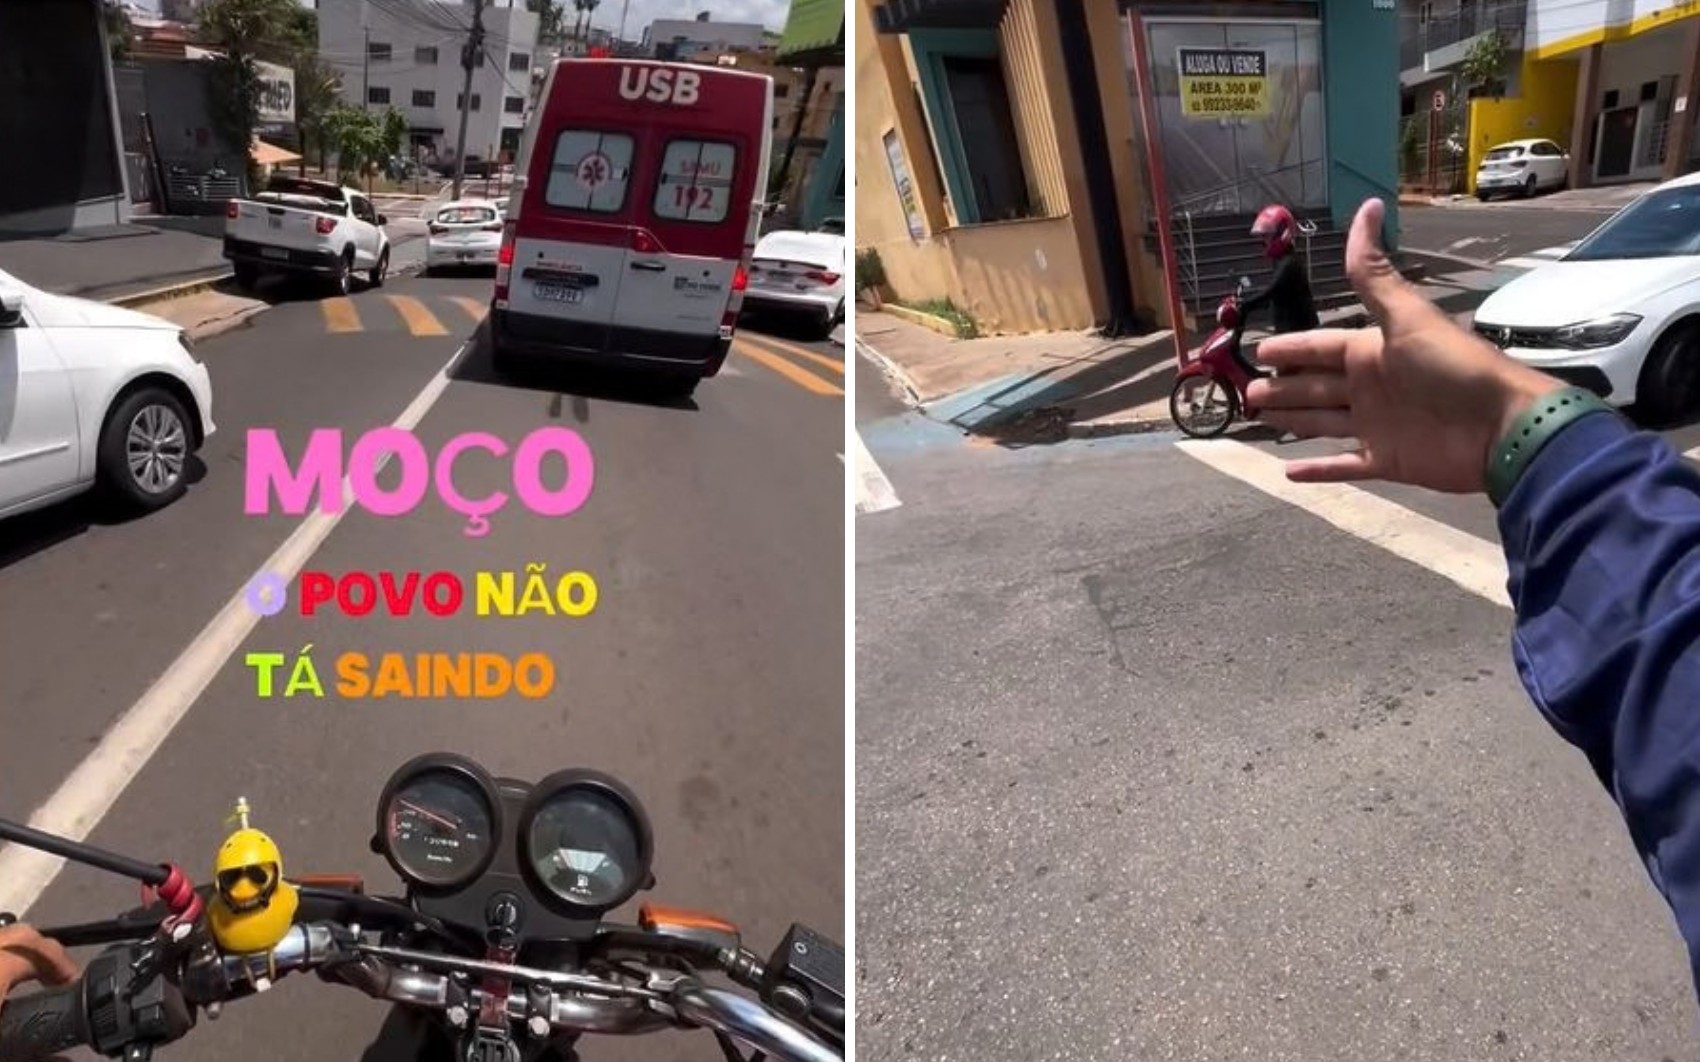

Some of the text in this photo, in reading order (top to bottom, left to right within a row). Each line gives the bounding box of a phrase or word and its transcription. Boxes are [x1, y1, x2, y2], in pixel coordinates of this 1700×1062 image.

[1185, 54, 1260, 74] ALUGA OU VENDE
[619, 66, 701, 105] USB
[1225, 82, 1246, 94] 300
[675, 185, 714, 209] 192
